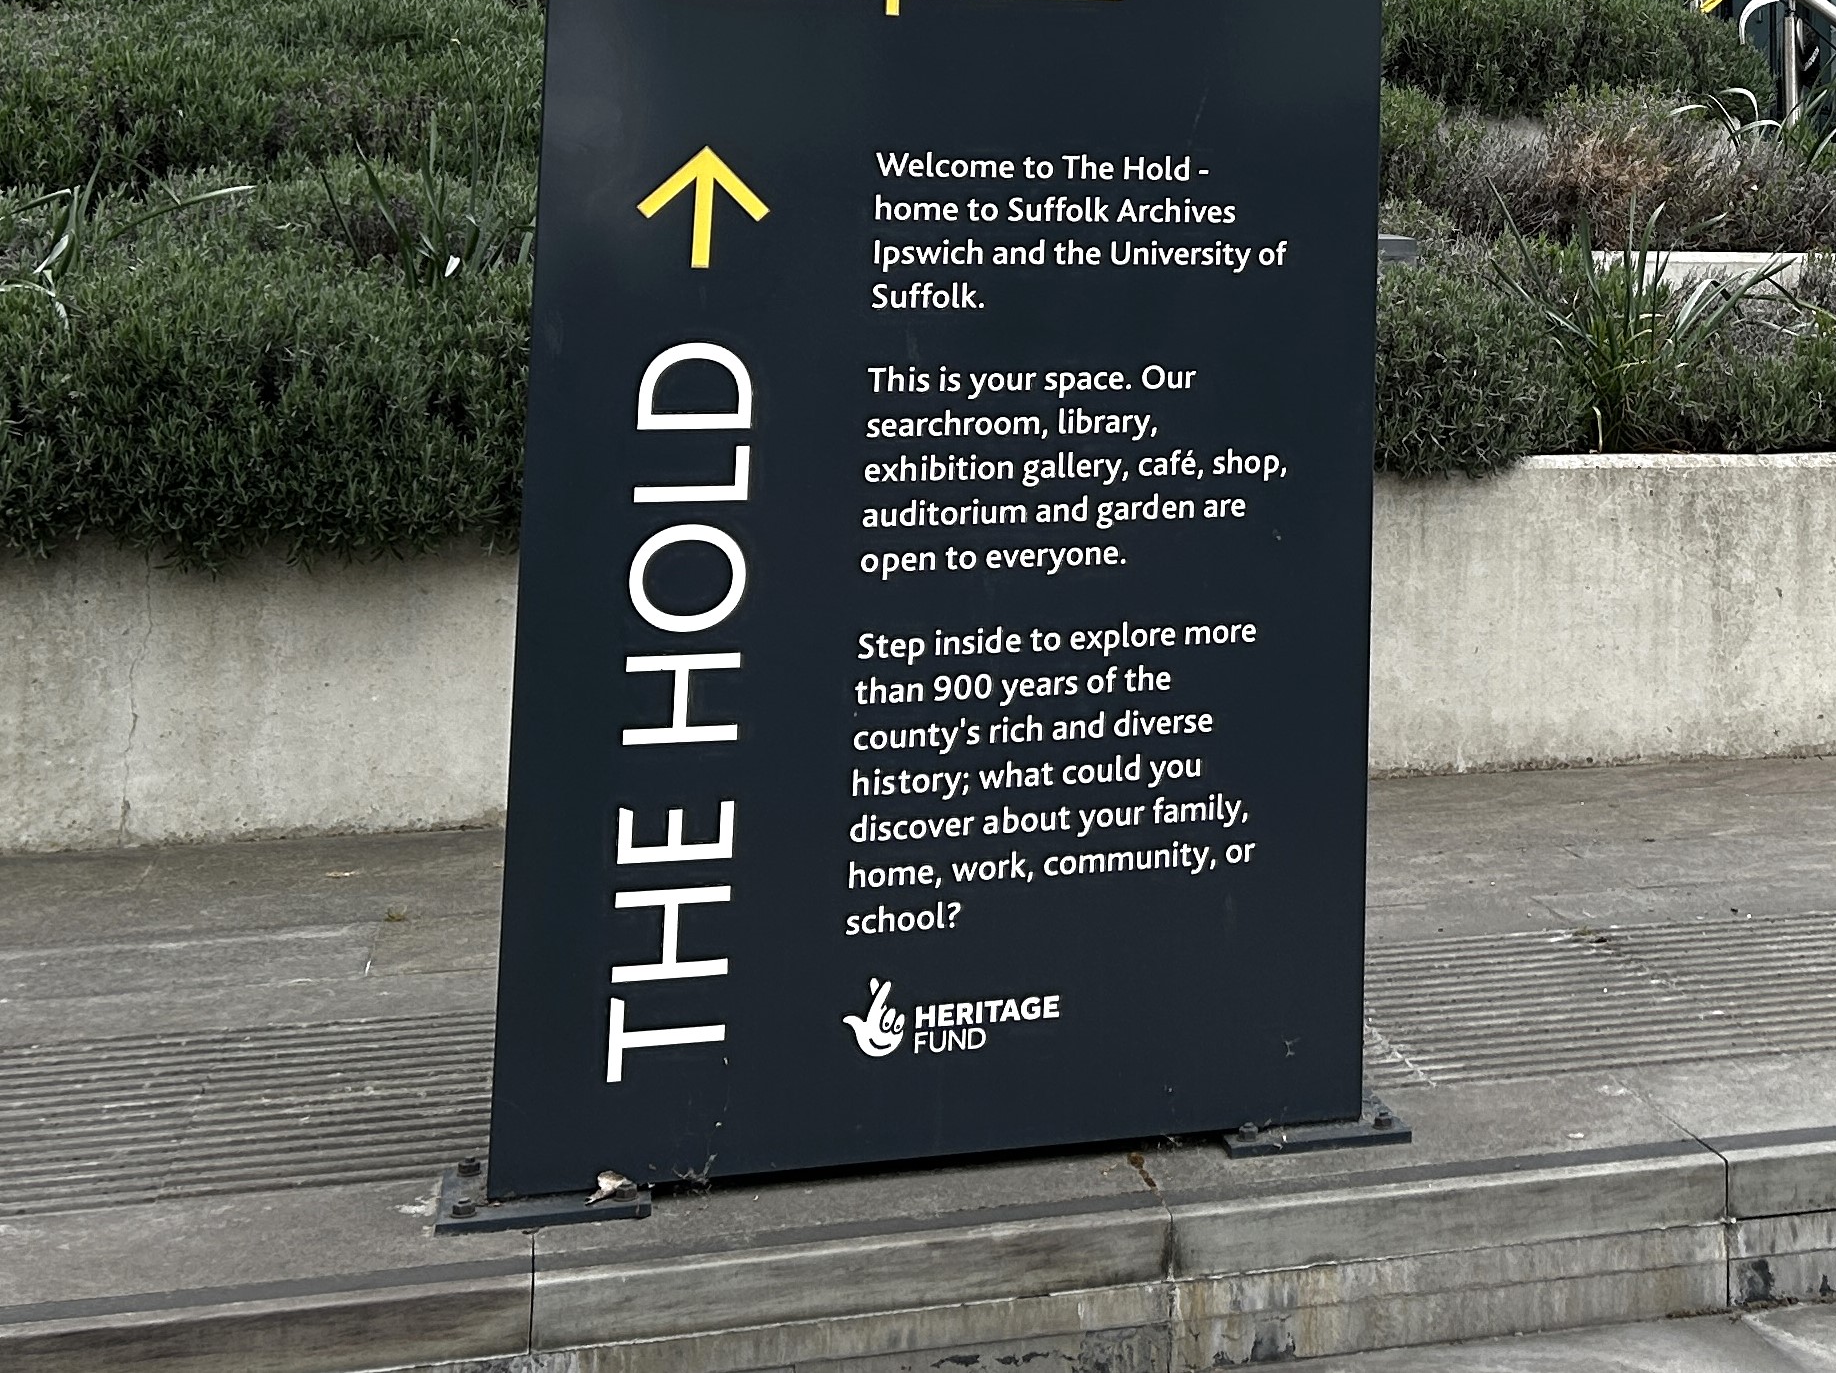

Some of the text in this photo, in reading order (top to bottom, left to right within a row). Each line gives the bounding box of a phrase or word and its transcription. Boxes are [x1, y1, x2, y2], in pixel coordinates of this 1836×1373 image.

[875, 151, 1015, 179] Welcome
[1022, 156, 1054, 179] to
[1061, 153, 1115, 181] The
[1123, 155, 1191, 182] Hold
[874, 194, 1236, 224] home to Suffolk Archives
[873, 238, 1288, 274] Ipswich and the University of
[871, 281, 985, 309] Suffolk.
[867, 364, 1197, 400] This is your space. Our
[865, 407, 1158, 442] searchroom, library,
[864, 447, 1287, 488] exhibition gallery, café, shop,
[862, 492, 1246, 530] auditorium and garden are
[860, 545, 1127, 581] open to everyone.
[857, 621, 1257, 666] Step inside to explore more
[854, 664, 1171, 707] than 900 years of the
[606, 342, 754, 1083] THE HOLD
[853, 709, 1213, 755] county's rich and diverse
[852, 753, 1201, 801] history; what could you
[849, 792, 1248, 843] discover about your family,
[848, 840, 1256, 889] home, work, community, or
[845, 901, 962, 936] school?
[915, 994, 1060, 1030] HERITAGE
[913, 1027, 987, 1054] FUND
